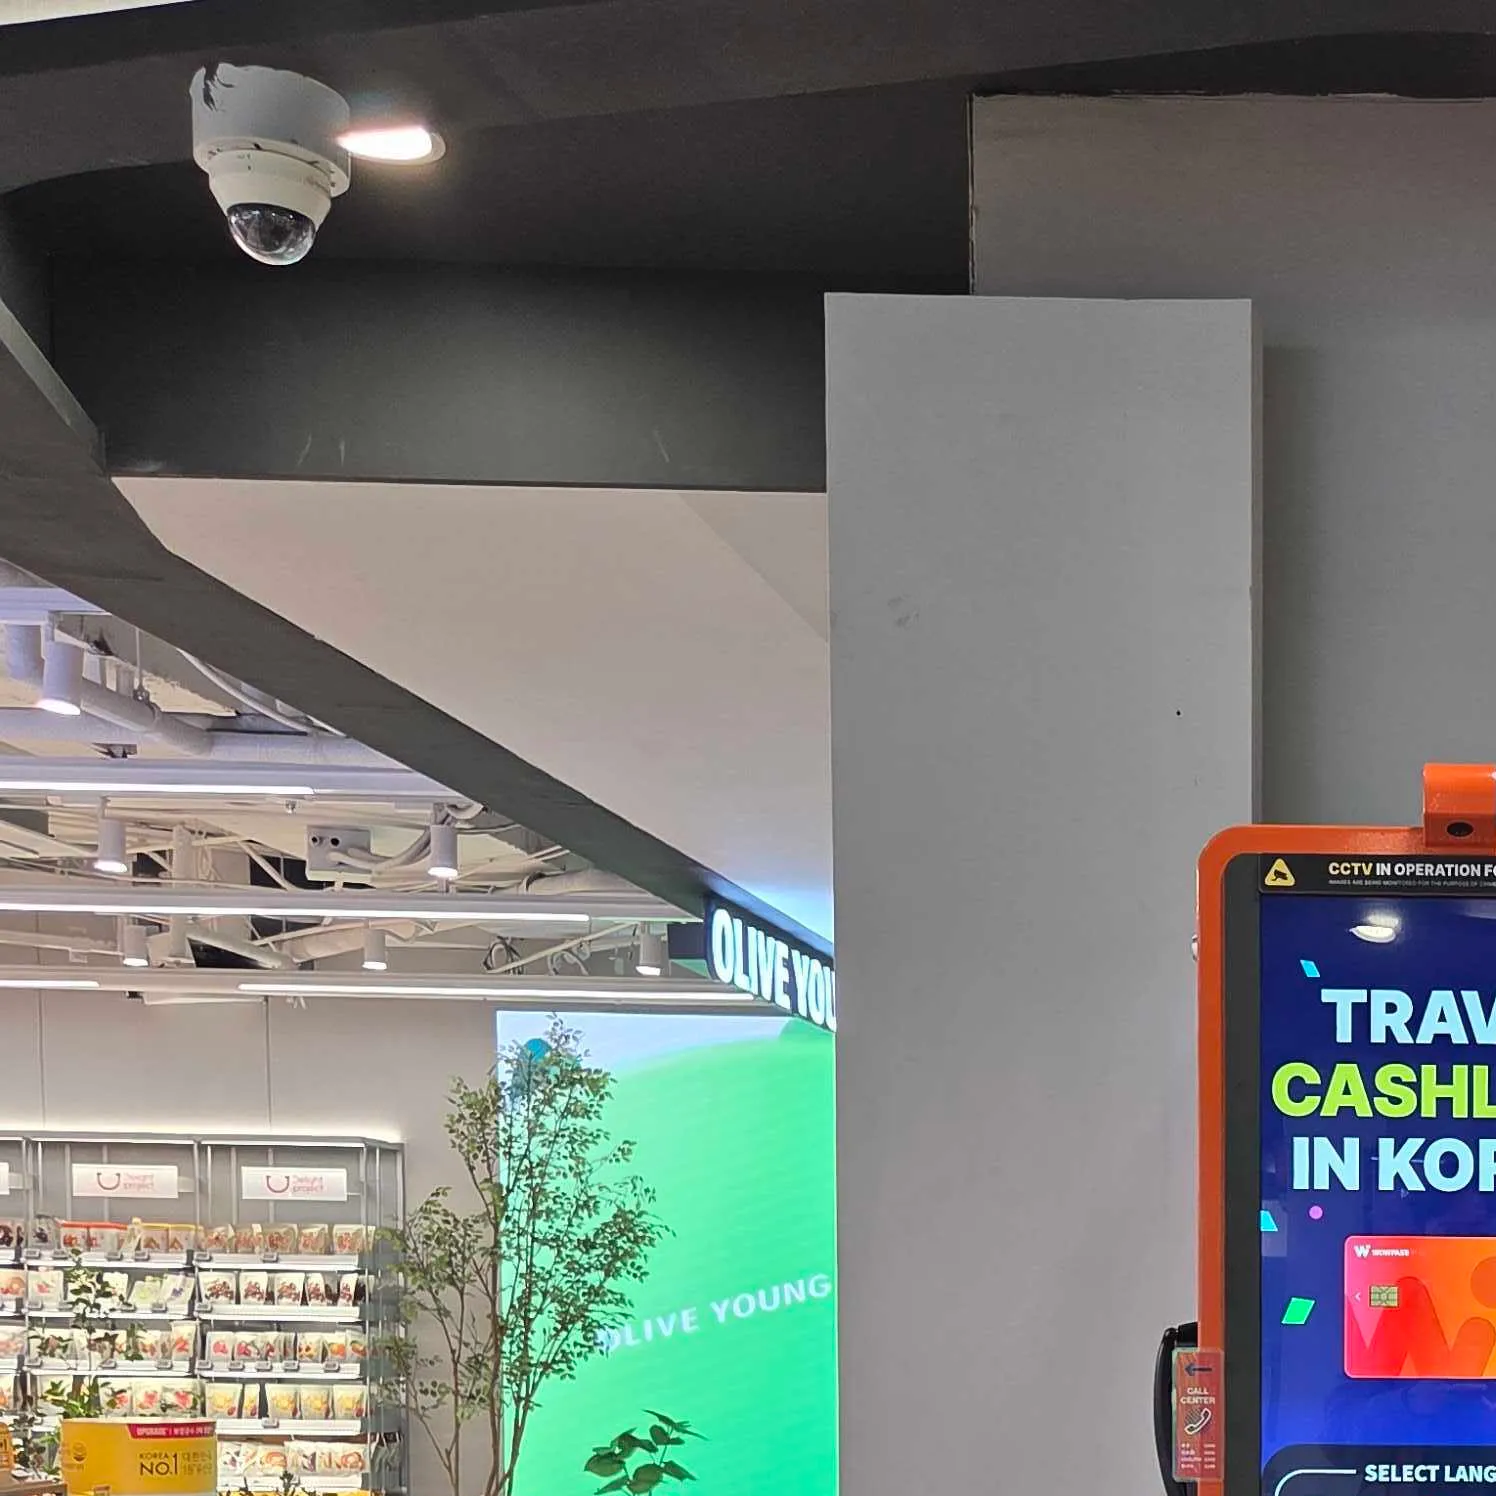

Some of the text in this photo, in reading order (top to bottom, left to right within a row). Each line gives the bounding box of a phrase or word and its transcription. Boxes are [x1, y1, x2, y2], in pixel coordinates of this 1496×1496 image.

[1328, 862, 1374, 876] CCTV
[1376, 863, 1391, 876] IN
[1394, 863, 1481, 877] OPERATION
[712, 908, 791, 1009] OLIVE
[1292, 1136, 1360, 1191] IN
[595, 1273, 832, 1350] OLIVE YOUNG
[1180, 1396, 1216, 1405] CENTER
[1187, 1387, 1209, 1395] CALL
[139, 1452, 169, 1460] KOREA
[139, 1453, 179, 1476] NO.1
[1364, 1464, 1440, 1483] SELECT
